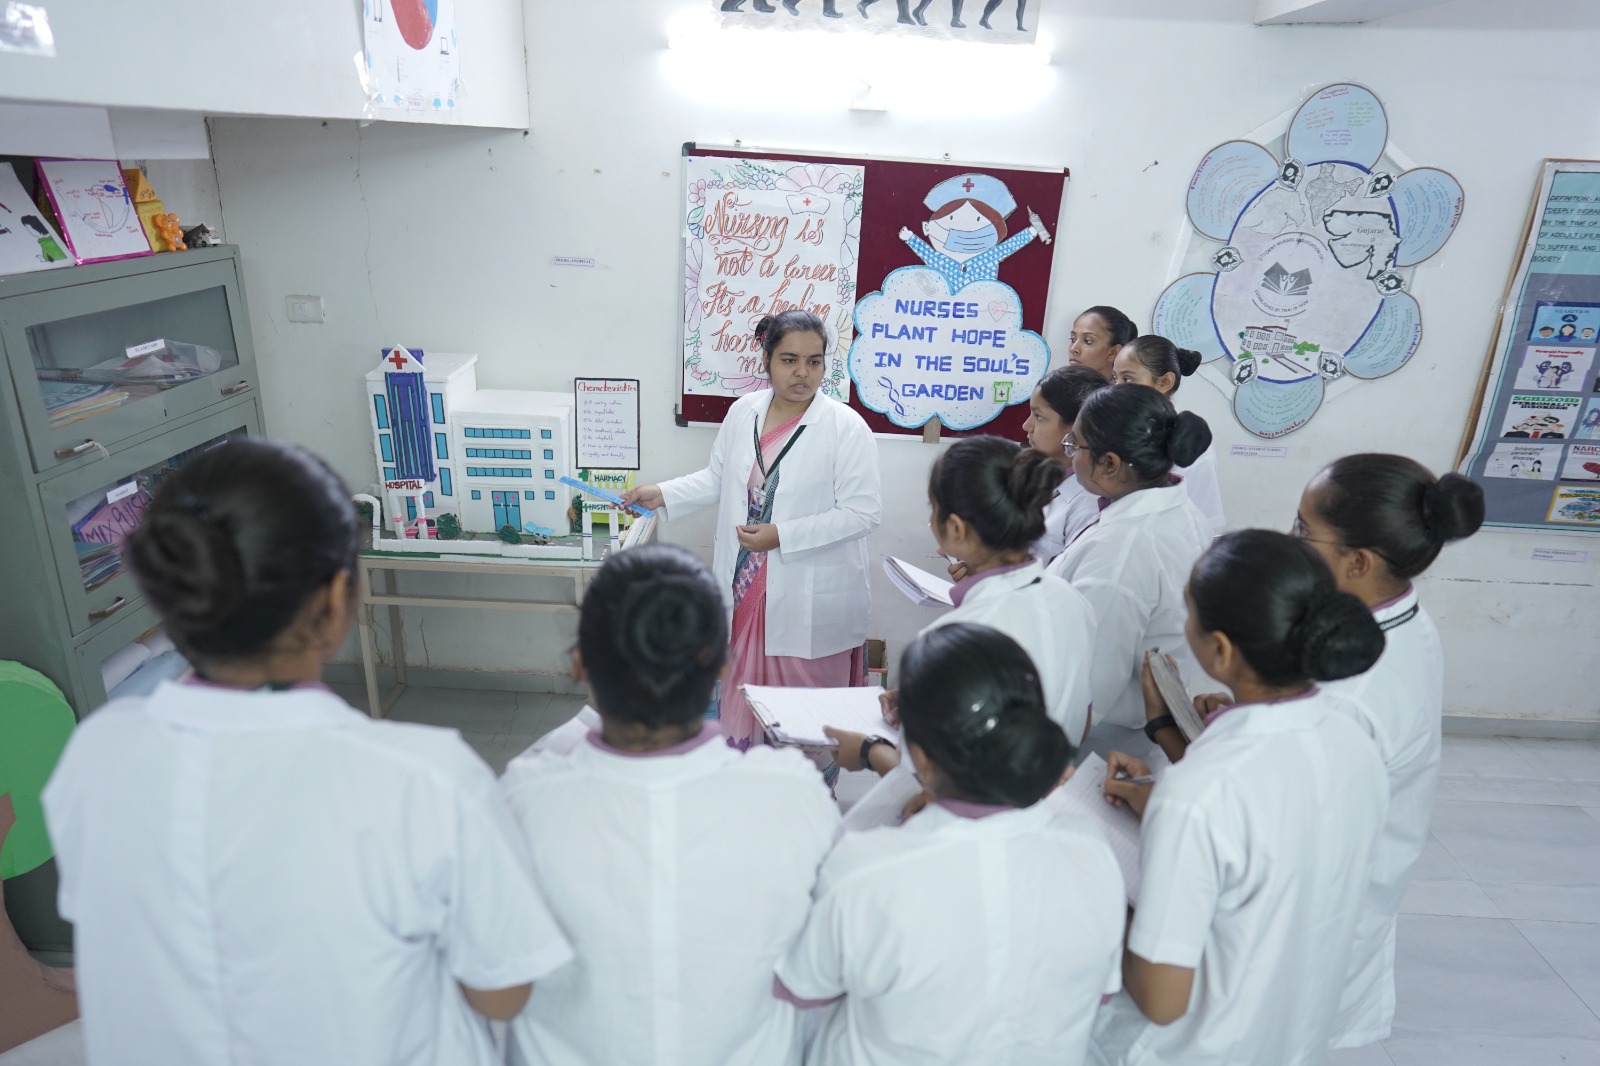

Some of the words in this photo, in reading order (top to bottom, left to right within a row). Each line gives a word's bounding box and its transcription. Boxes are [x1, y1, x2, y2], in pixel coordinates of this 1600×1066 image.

[703, 191, 789, 257] Nursing
[794, 213, 825, 246] is
[1357, 227, 1384, 235] Gujarat
[714, 246, 754, 277] not
[738, 295, 765, 314] a
[895, 299, 978, 318] NURSES
[871, 322, 938, 343] PLANT
[951, 328, 1006, 348] HOPE
[874, 352, 902, 368] IN
[915, 355, 952, 372] THE
[963, 353, 1030, 375] SOUL'S
[901, 383, 984, 401] GARDEN
[385, 480, 422, 490] HOSPITAL
[594, 474, 627, 483] HARMACY
[588, 503, 616, 511] HOSPIT
